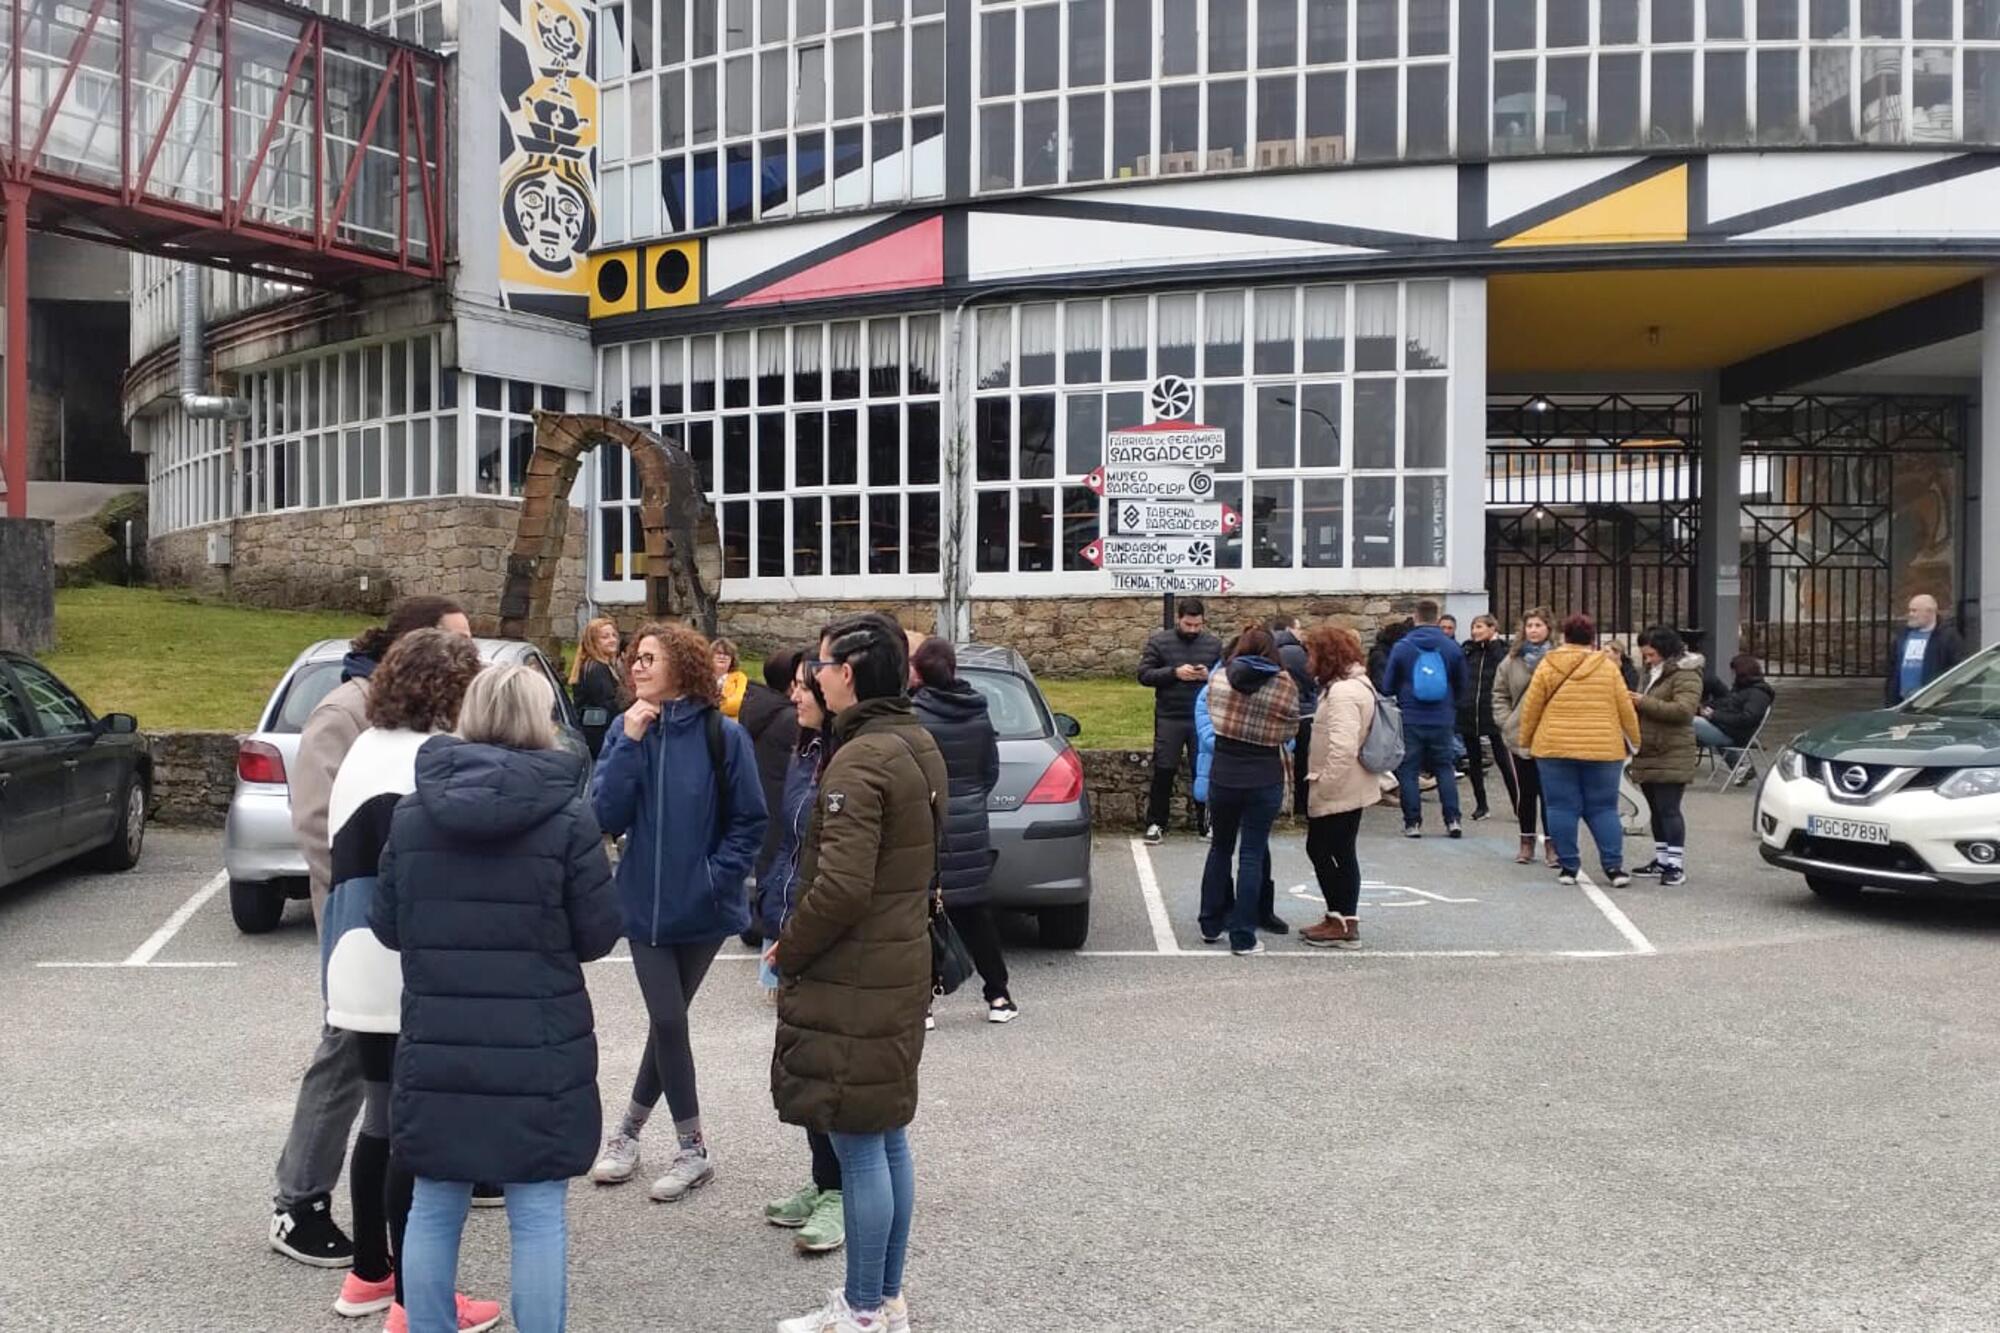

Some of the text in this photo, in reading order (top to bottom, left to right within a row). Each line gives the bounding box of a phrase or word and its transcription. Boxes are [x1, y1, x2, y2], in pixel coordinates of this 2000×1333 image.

[1109, 445, 1223, 462] SARGADELOS
[1106, 471, 1149, 482] MUSEO
[1106, 482, 1185, 495] SARGADELOS
[1145, 506, 1195, 518] TABERNA
[1145, 518, 1220, 530] SARGADELOS
[1104, 541, 1168, 553] FUNDACIÓN
[1104, 553, 1186, 565] SARGADELOS
